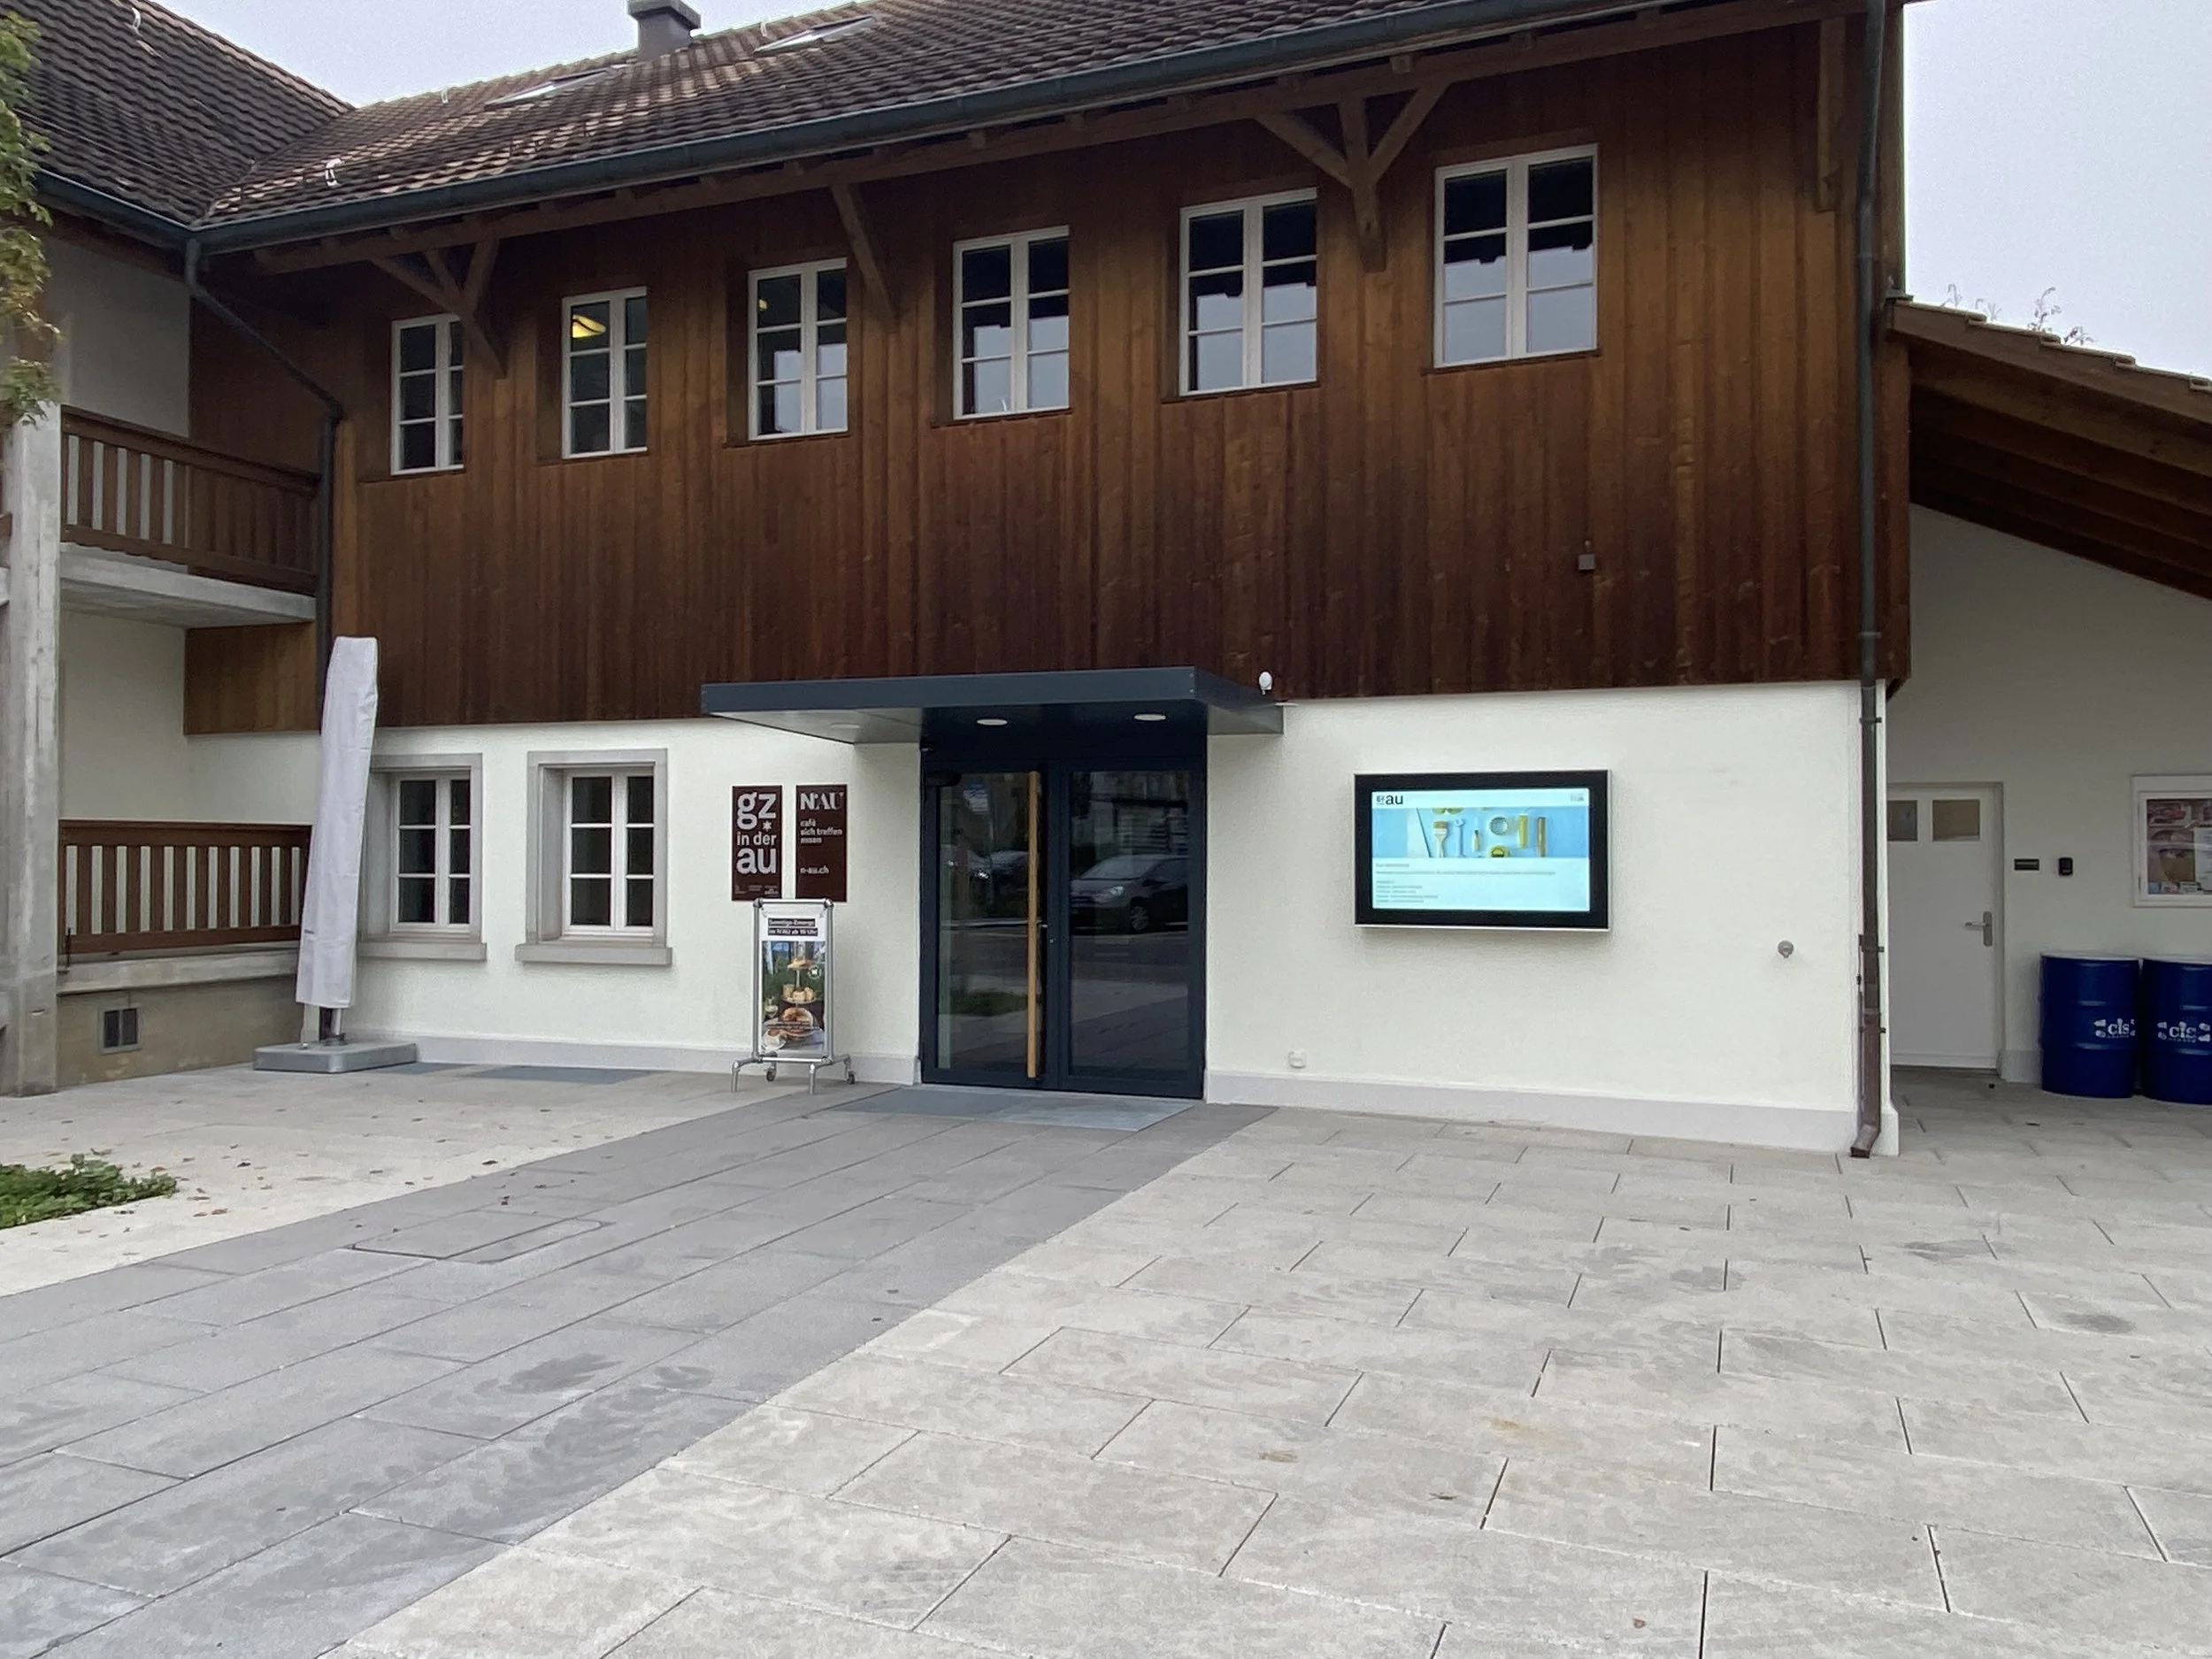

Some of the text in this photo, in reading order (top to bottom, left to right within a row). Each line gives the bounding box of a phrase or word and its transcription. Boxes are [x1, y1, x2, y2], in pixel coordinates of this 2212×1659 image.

[1386, 795, 1404, 805] au
[737, 792, 777, 830] gz
[737, 832, 777, 846] in der
[736, 848, 777, 874] au
